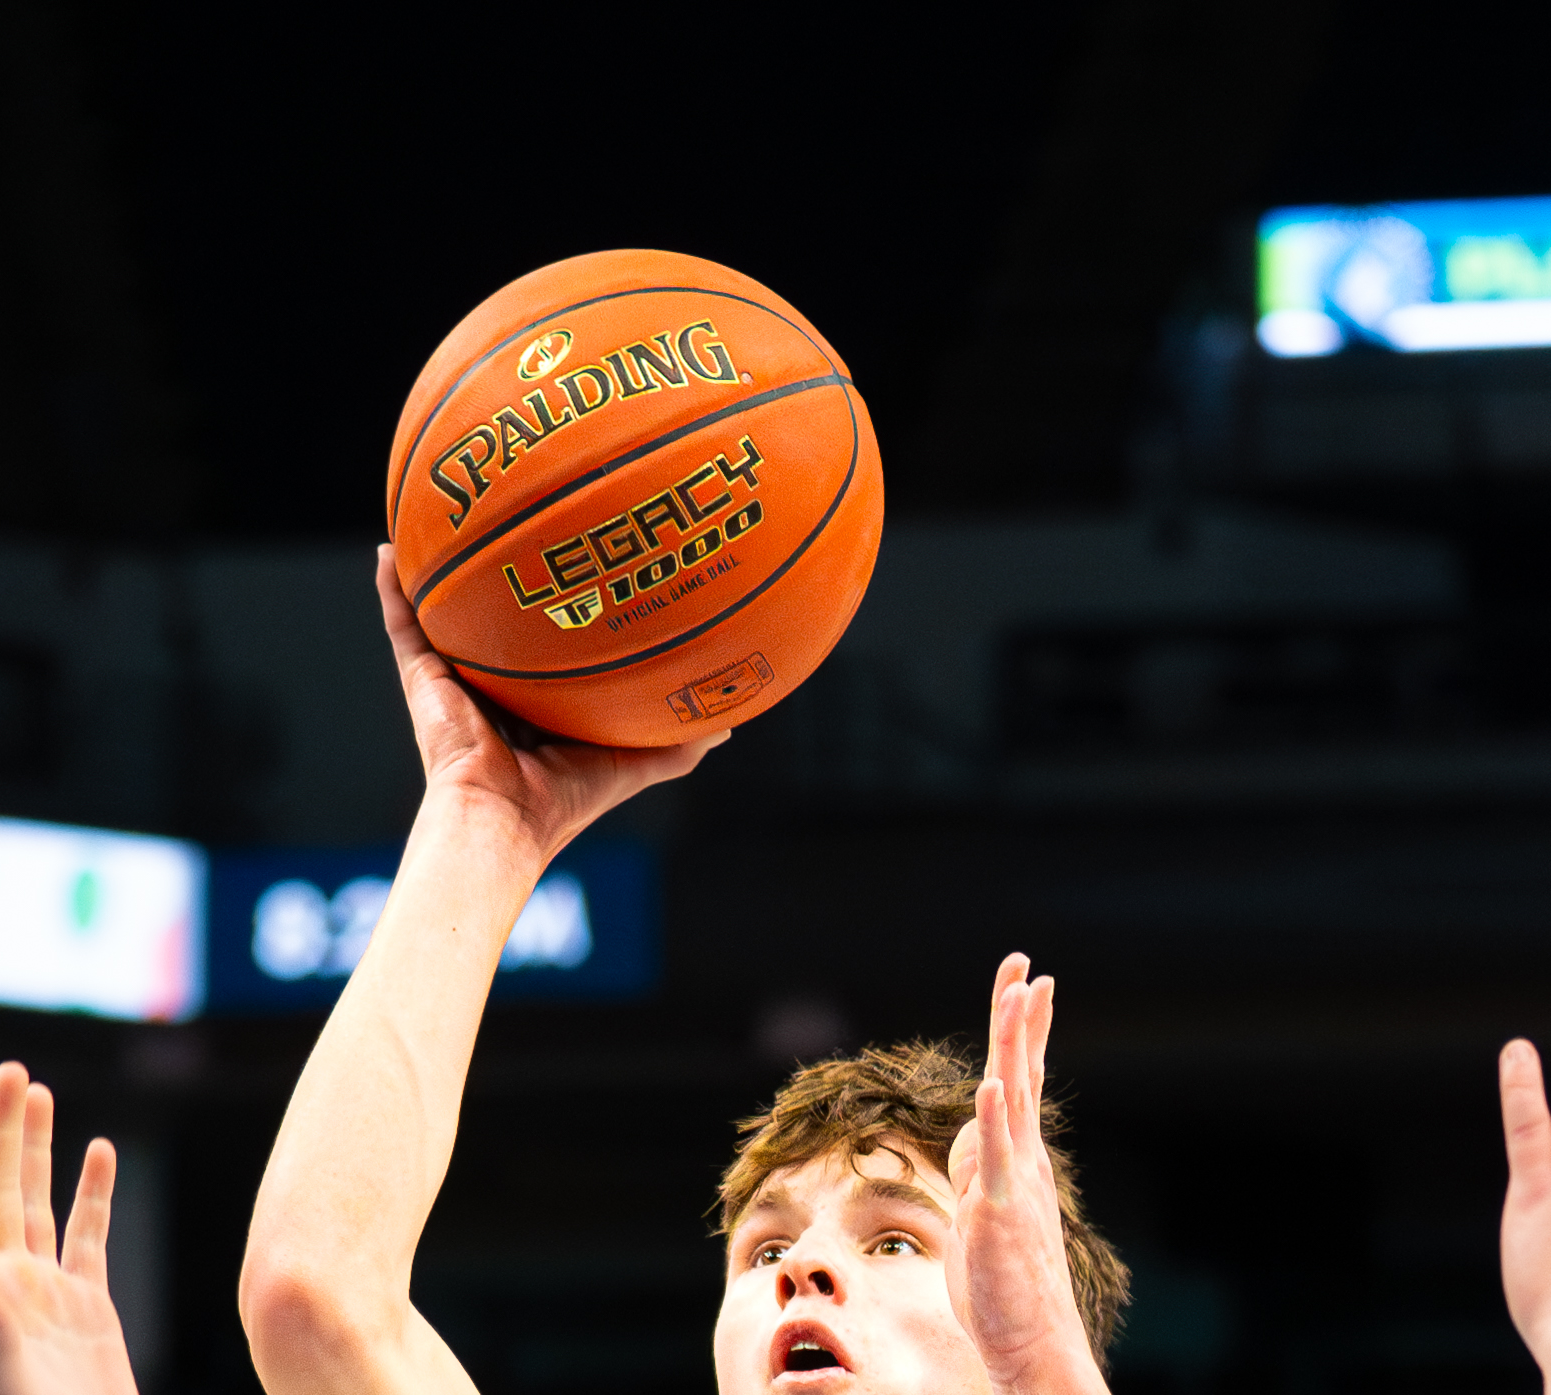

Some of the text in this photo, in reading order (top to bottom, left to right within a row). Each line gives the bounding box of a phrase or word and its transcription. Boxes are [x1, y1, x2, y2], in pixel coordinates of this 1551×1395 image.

[429, 318, 742, 530] SPALDING
[502, 434, 765, 610] LEGACY
[606, 498, 765, 606] 1000
[606, 553, 741, 633] OFFICIAL GAME BALL
